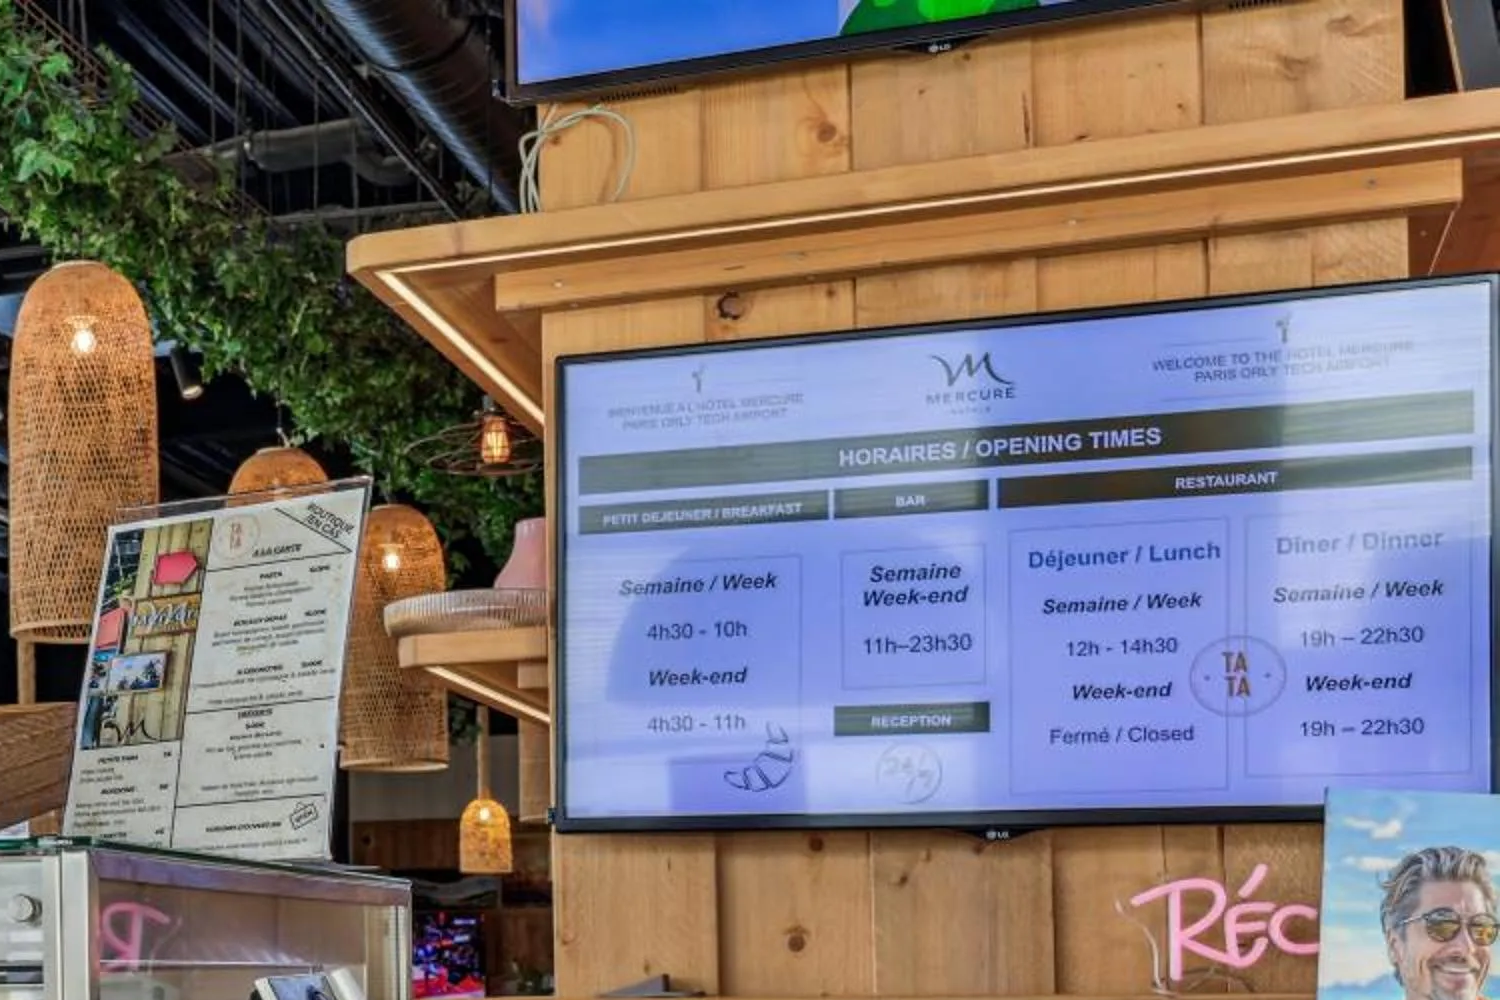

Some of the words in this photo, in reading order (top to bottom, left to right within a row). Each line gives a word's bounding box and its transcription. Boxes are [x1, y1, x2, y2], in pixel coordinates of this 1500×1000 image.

[1153, 356, 1227, 372] WELCOME
[1230, 352, 1251, 366] TO
[1254, 349, 1283, 364] THE
[1194, 369, 1237, 383] PARIS
[925, 386, 1016, 405] MERCURE
[838, 441, 957, 468] HORAIRES
[974, 432, 1082, 457] OPENING
[1088, 427, 1163, 450] TIMES
[1174, 471, 1279, 489] RESTAURANT
[894, 495, 926, 508] BAR
[602, 512, 638, 527] PETIT
[721, 502, 804, 519] BREAKFAST
[1362, 531, 1445, 550] Dinner
[1028, 549, 1129, 571] Déjeuner
[1134, 545, 1143, 564] /
[1149, 542, 1222, 562] Lunch
[619, 577, 705, 597] Semaine
[708, 575, 718, 593] /
[722, 571, 779, 591] Week
[869, 563, 962, 583] Semaine
[862, 584, 970, 607] Week-end
[1272, 584, 1366, 603] Semaine
[1370, 582, 1379, 600] /
[1384, 579, 1445, 598] Week
[1042, 596, 1129, 615] Semaine
[1132, 594, 1143, 611] /
[1147, 592, 1204, 609] Week
[647, 622, 694, 642] 4h30
[713, 620, 749, 639] 10h
[1300, 630, 1336, 648] 19h
[1360, 626, 1426, 645] 22h30
[1066, 640, 1100, 657] 12h
[1120, 636, 1179, 655] 14h30
[1221, 651, 1248, 673] TA
[648, 664, 749, 687] Week-end
[1225, 675, 1252, 697] TA
[1305, 672, 1413, 692] Week-end
[1071, 681, 1173, 701] Week-end
[647, 715, 694, 734] 4h30
[713, 713, 747, 731] 11h
[871, 714, 953, 729] RECEPTION
[1300, 720, 1336, 737] 19h
[1360, 717, 1426, 736] 22h30
[1050, 726, 1110, 745] Fermé
[1115, 726, 1122, 743] /
[1127, 724, 1195, 743] Closed
[1131, 863, 1321, 982] RÉC
